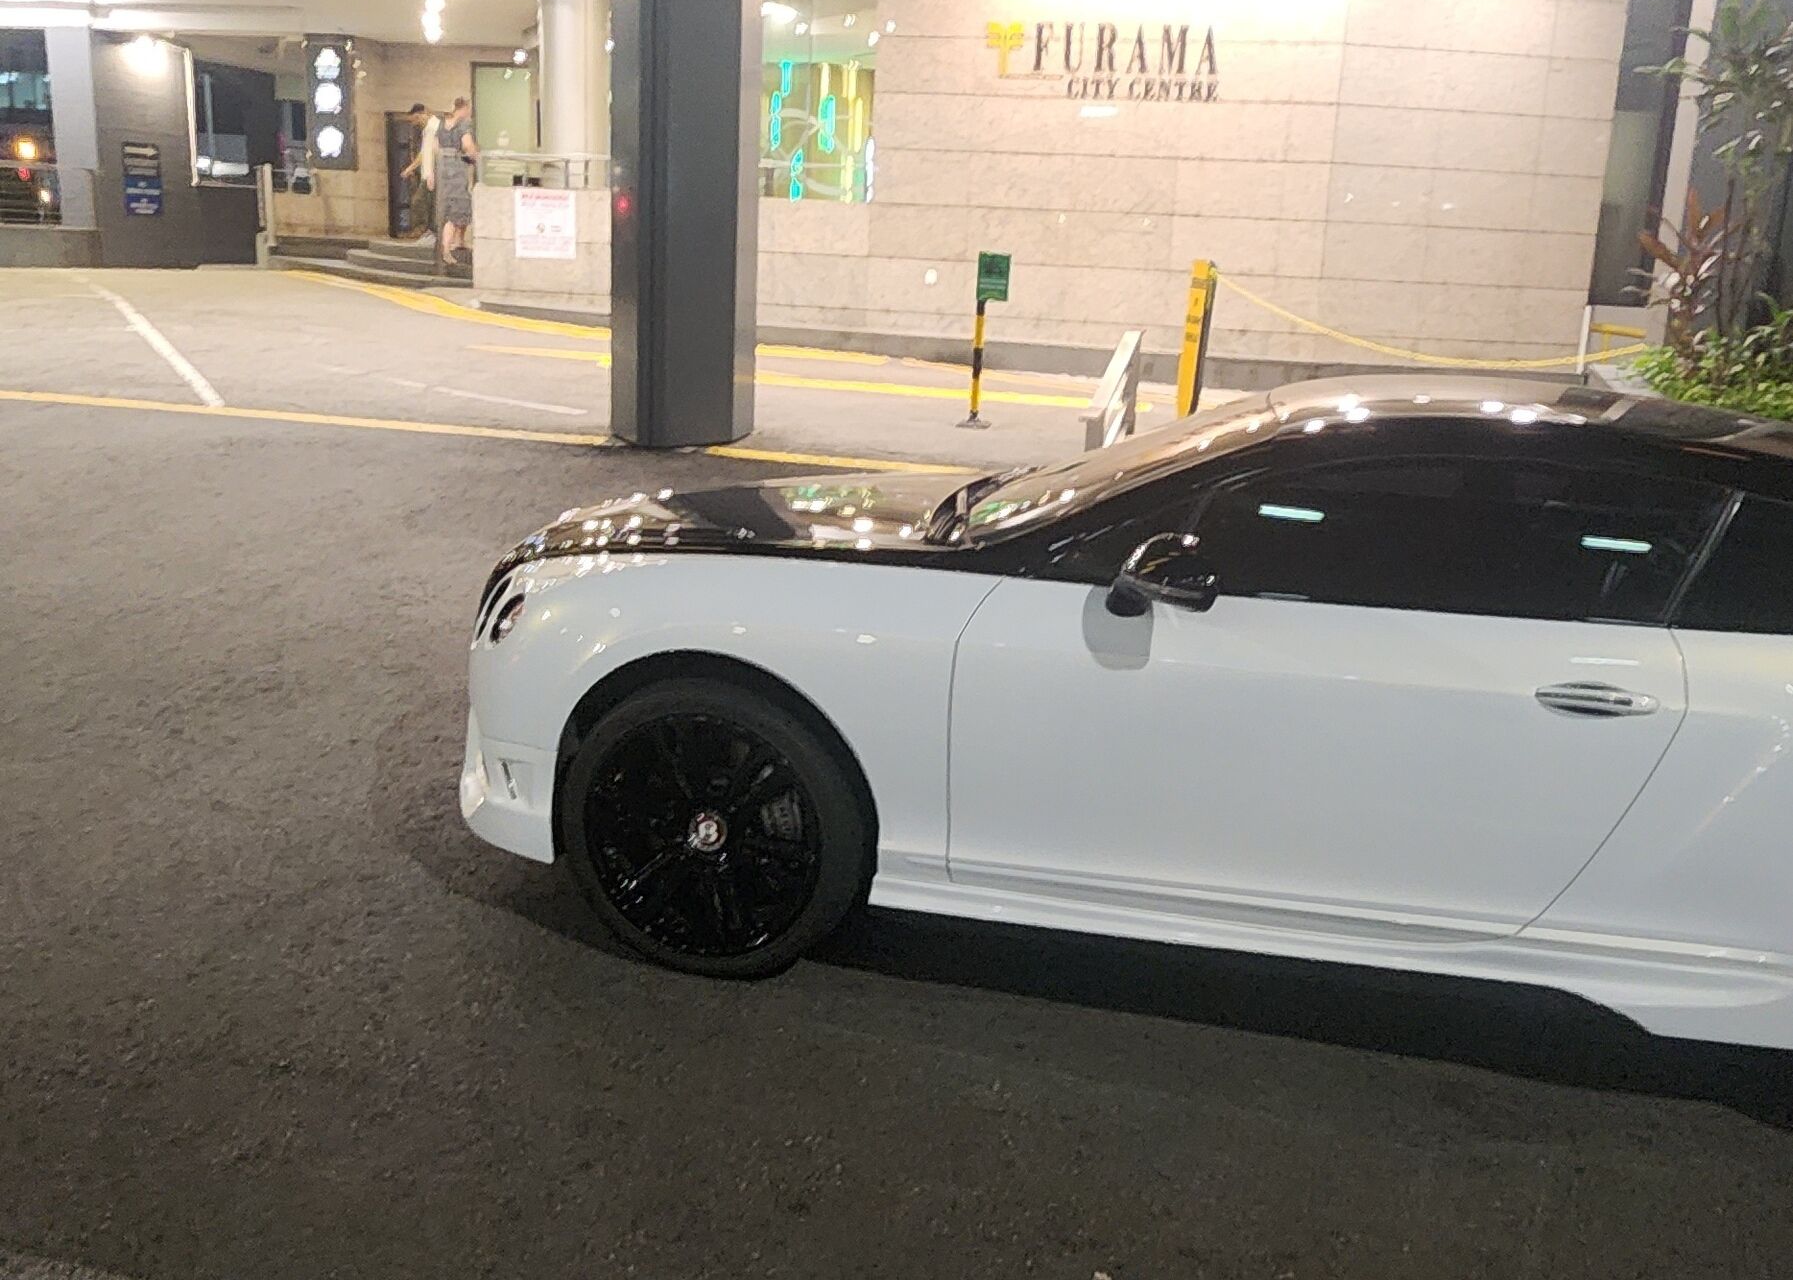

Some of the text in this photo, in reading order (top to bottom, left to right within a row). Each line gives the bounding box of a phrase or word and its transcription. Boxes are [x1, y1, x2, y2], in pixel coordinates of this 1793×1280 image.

[1033, 22, 1219, 75] FURAMA
[1066, 77, 1220, 104] CITY CENTRE
